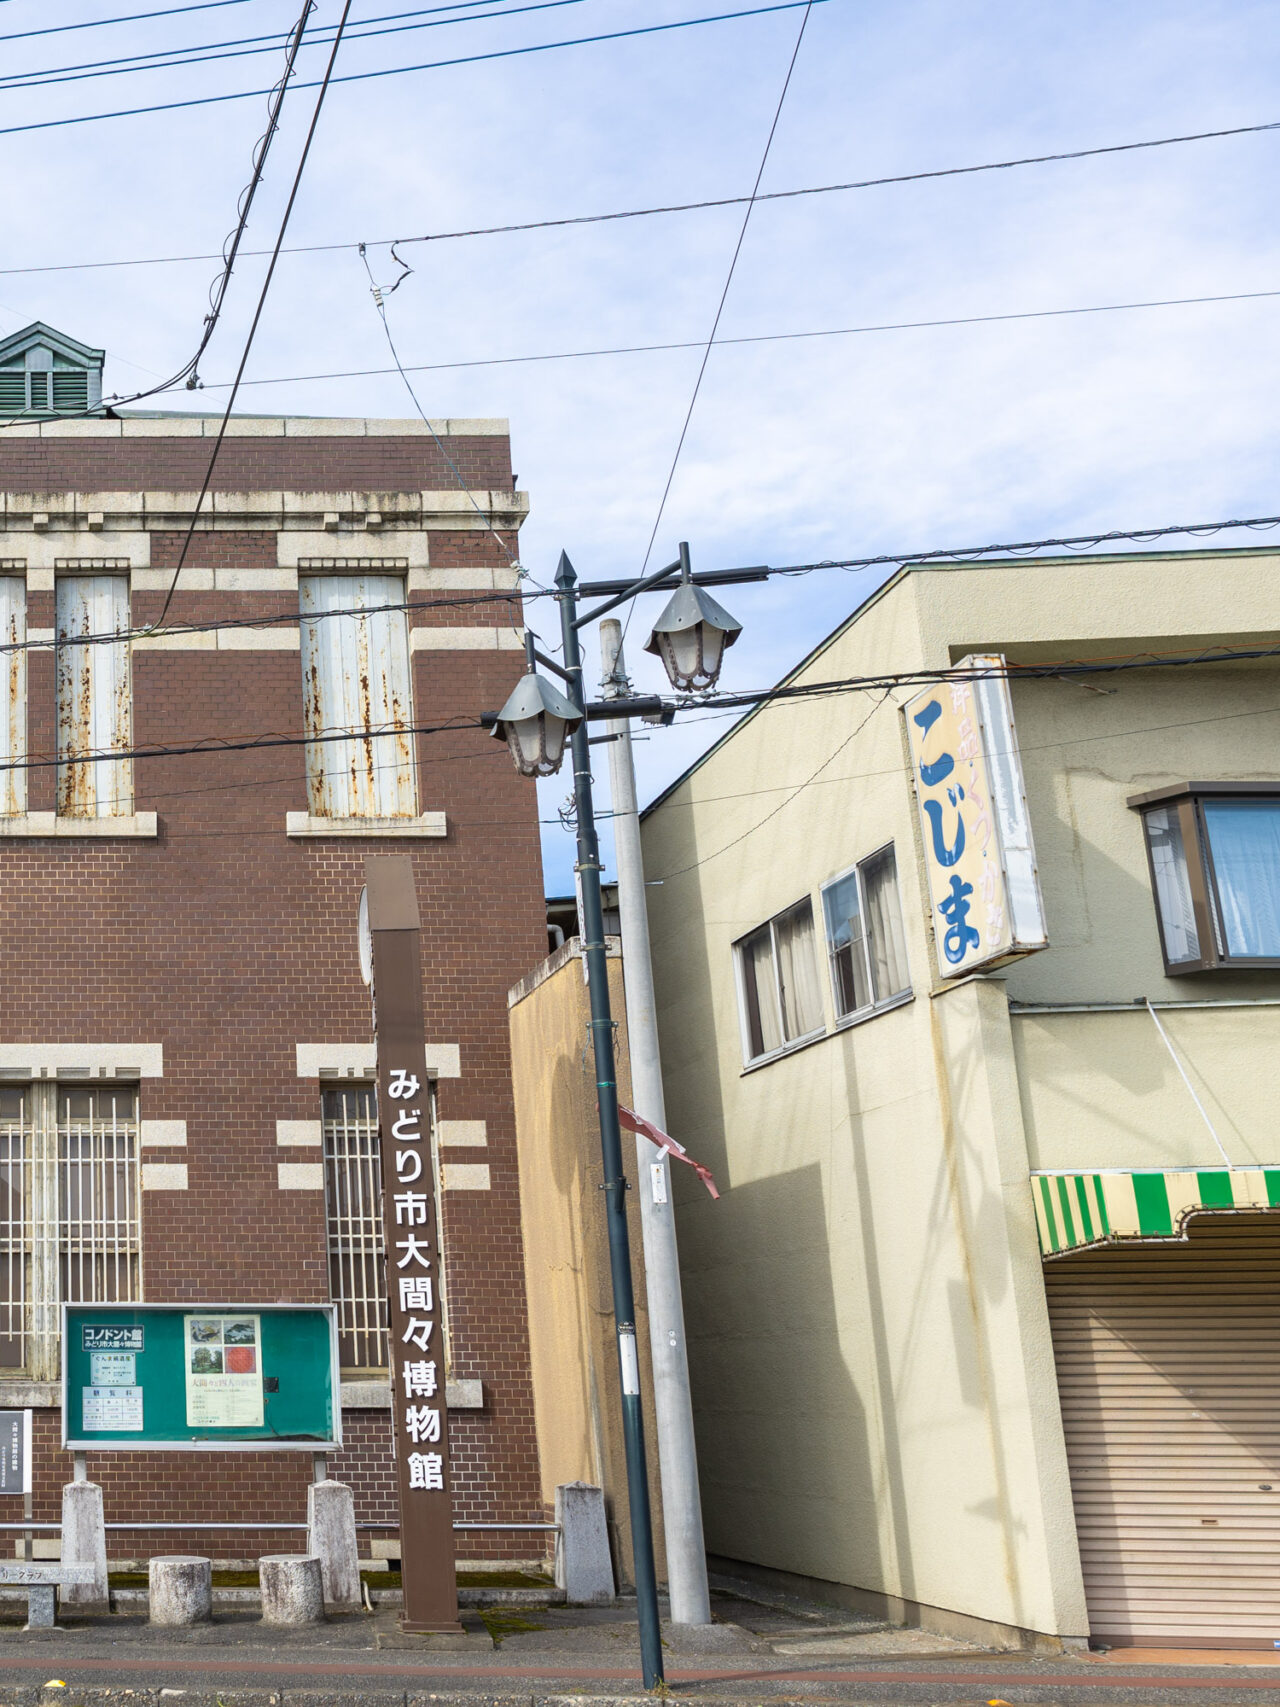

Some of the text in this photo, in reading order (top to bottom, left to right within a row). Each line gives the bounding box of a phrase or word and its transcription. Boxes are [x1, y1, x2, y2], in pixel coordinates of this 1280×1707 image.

[913, 699, 980, 964] こじま
[84, 1329, 143, 1341] コノドント館
[387, 1068, 445, 1491] みどり市大間々博物館
